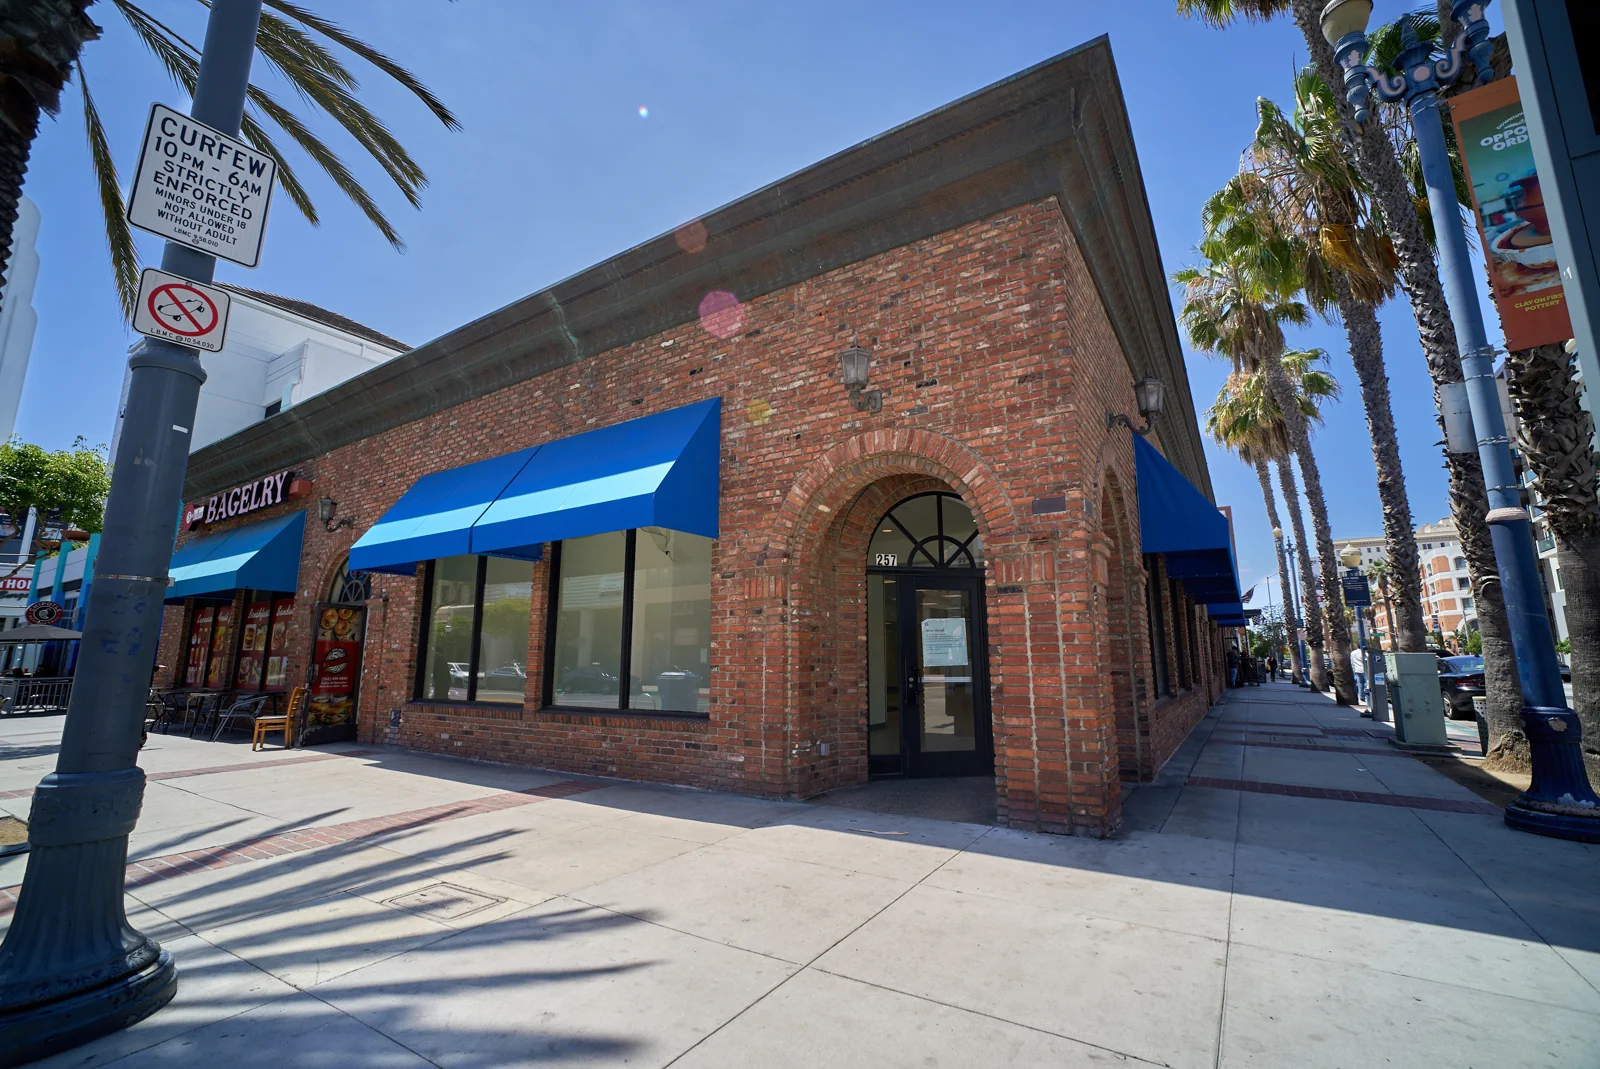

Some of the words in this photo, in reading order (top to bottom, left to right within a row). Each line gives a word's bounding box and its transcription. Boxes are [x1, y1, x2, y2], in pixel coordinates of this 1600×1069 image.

[161, 117, 266, 178] CURFEW
[153, 171, 252, 220] ENFORCED
[163, 160, 250, 204] STRICTLY
[155, 187, 196, 210] MINORS
[200, 205, 234, 225] UNDER
[237, 220, 247, 230] 18
[158, 209, 203, 232] WITHOUT
[205, 228, 238, 245] ADULT
[164, 201, 186, 215] NOT
[188, 211, 235, 234] ALLOWED
[1514, 300, 1533, 309] CLAY
[1524, 299, 1560, 312] POTTERY
[205, 470, 289, 524] BAGELRY
[877, 554, 896, 566] 257
